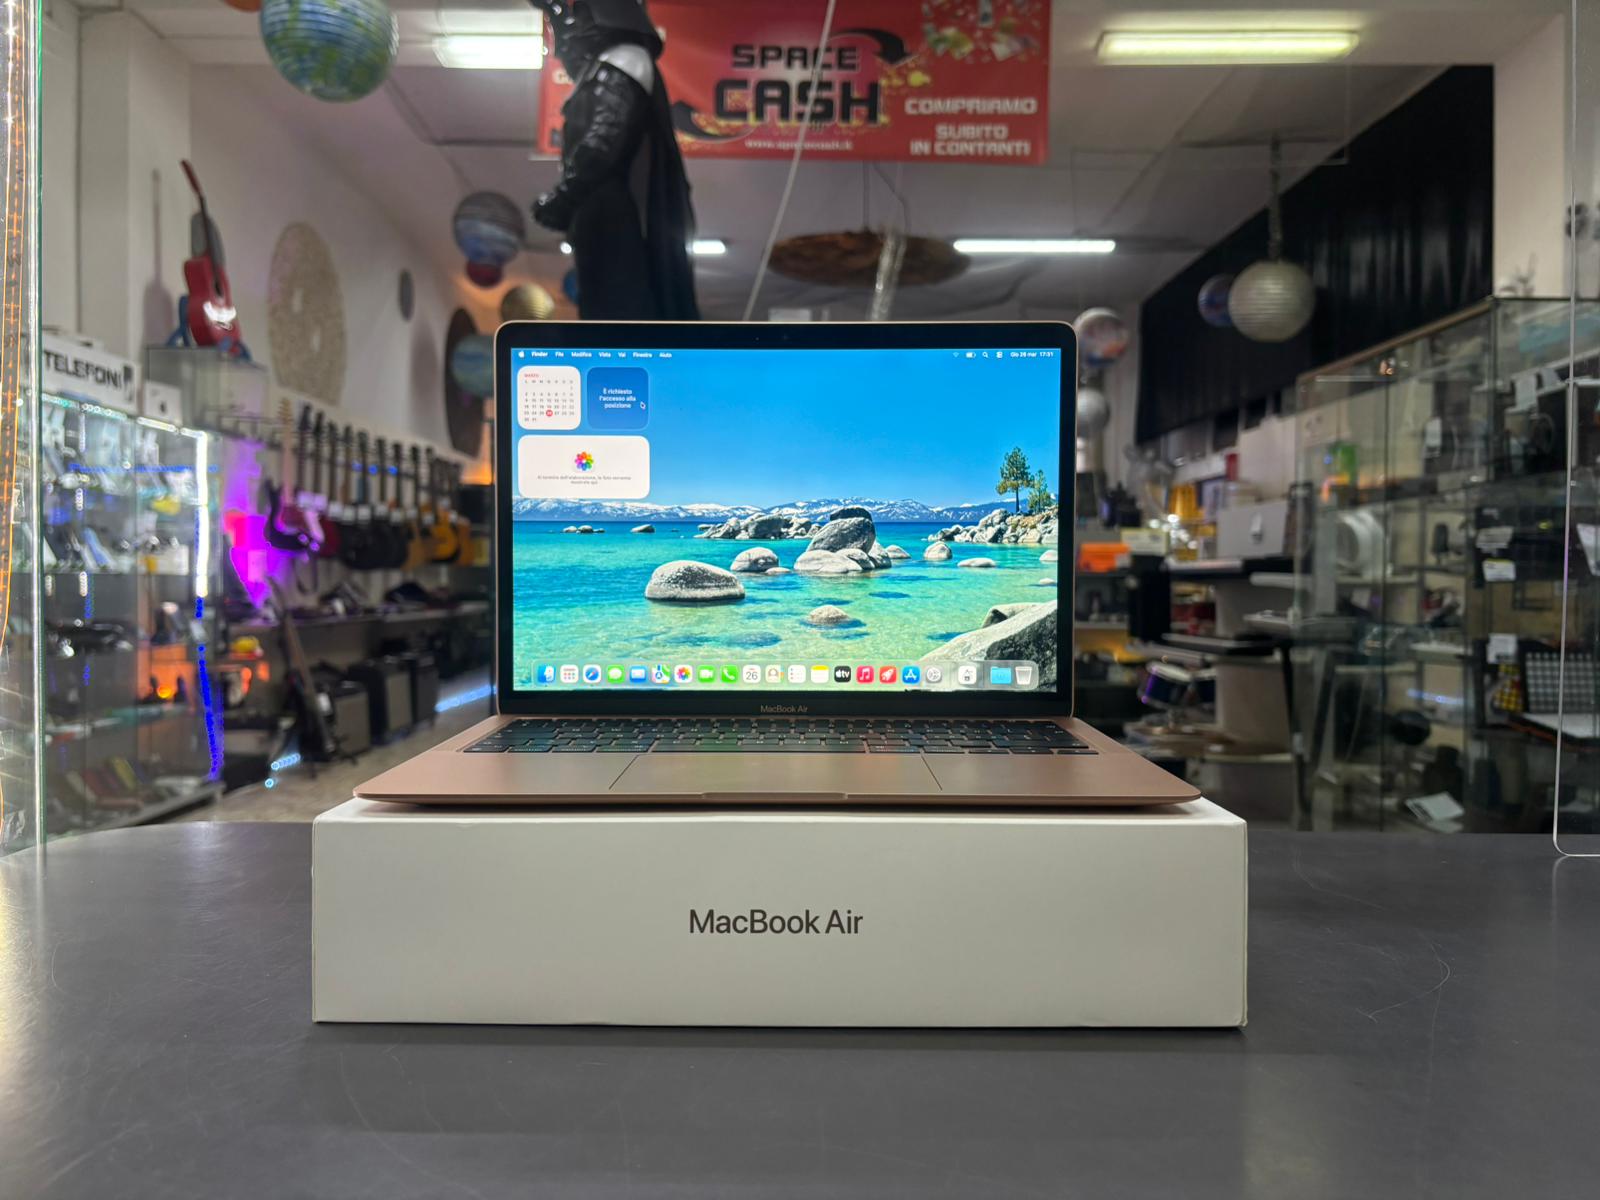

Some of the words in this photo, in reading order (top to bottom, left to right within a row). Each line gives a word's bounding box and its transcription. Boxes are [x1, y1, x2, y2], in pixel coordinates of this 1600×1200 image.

[732, 44, 859, 71] SPACE
[714, 79, 881, 124] CASH
[904, 97, 1038, 115] COMPRIAMO
[935, 124, 1009, 140] SUBITO
[910, 140, 930, 156] IN
[934, 140, 1031, 156] CONTANTI
[746, 671, 758, 680] 26
[760, 704, 796, 712] MacBook
[689, 908, 820, 934] MacBook
[824, 909, 864, 934] Air
